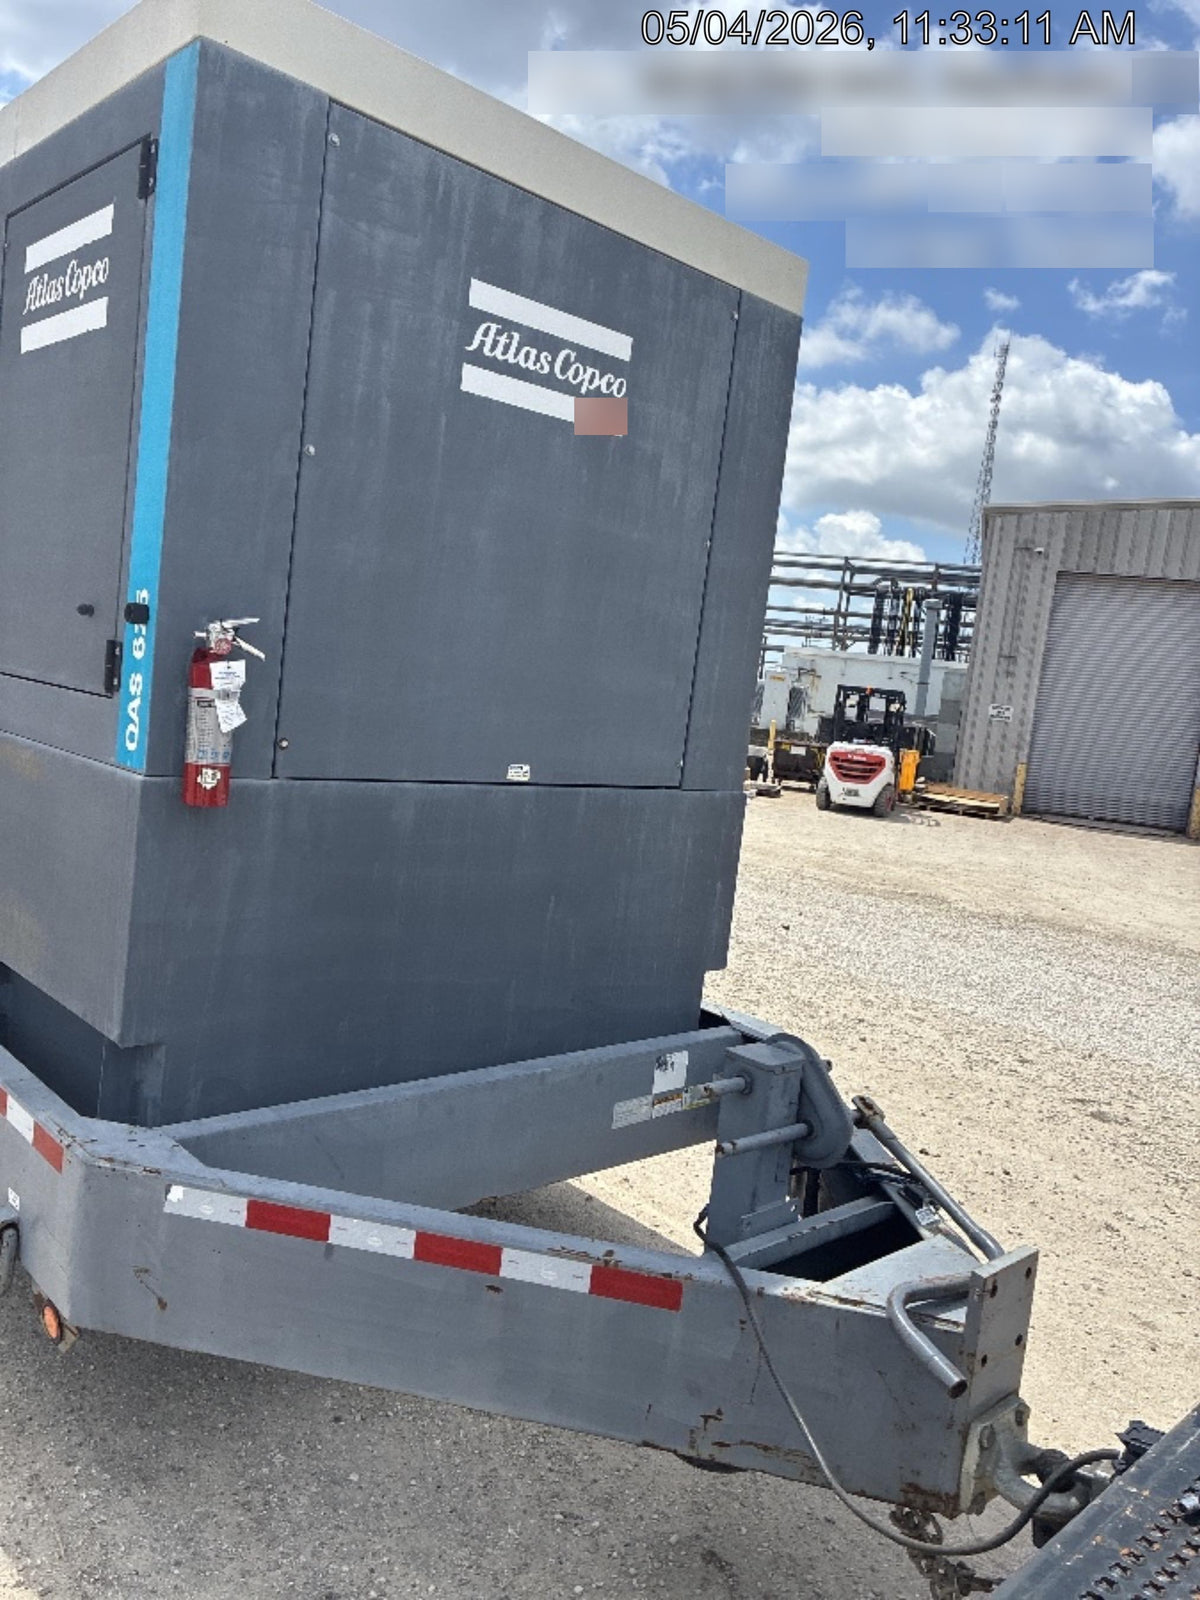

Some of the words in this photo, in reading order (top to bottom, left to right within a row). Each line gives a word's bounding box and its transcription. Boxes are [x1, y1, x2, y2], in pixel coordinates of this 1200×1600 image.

[22, 272, 65, 315] Atlas
[65, 257, 109, 300] Copco
[465, 321, 552, 374] Atlas
[554, 348, 627, 398] Copco
[125, 672, 143, 751] QAS
